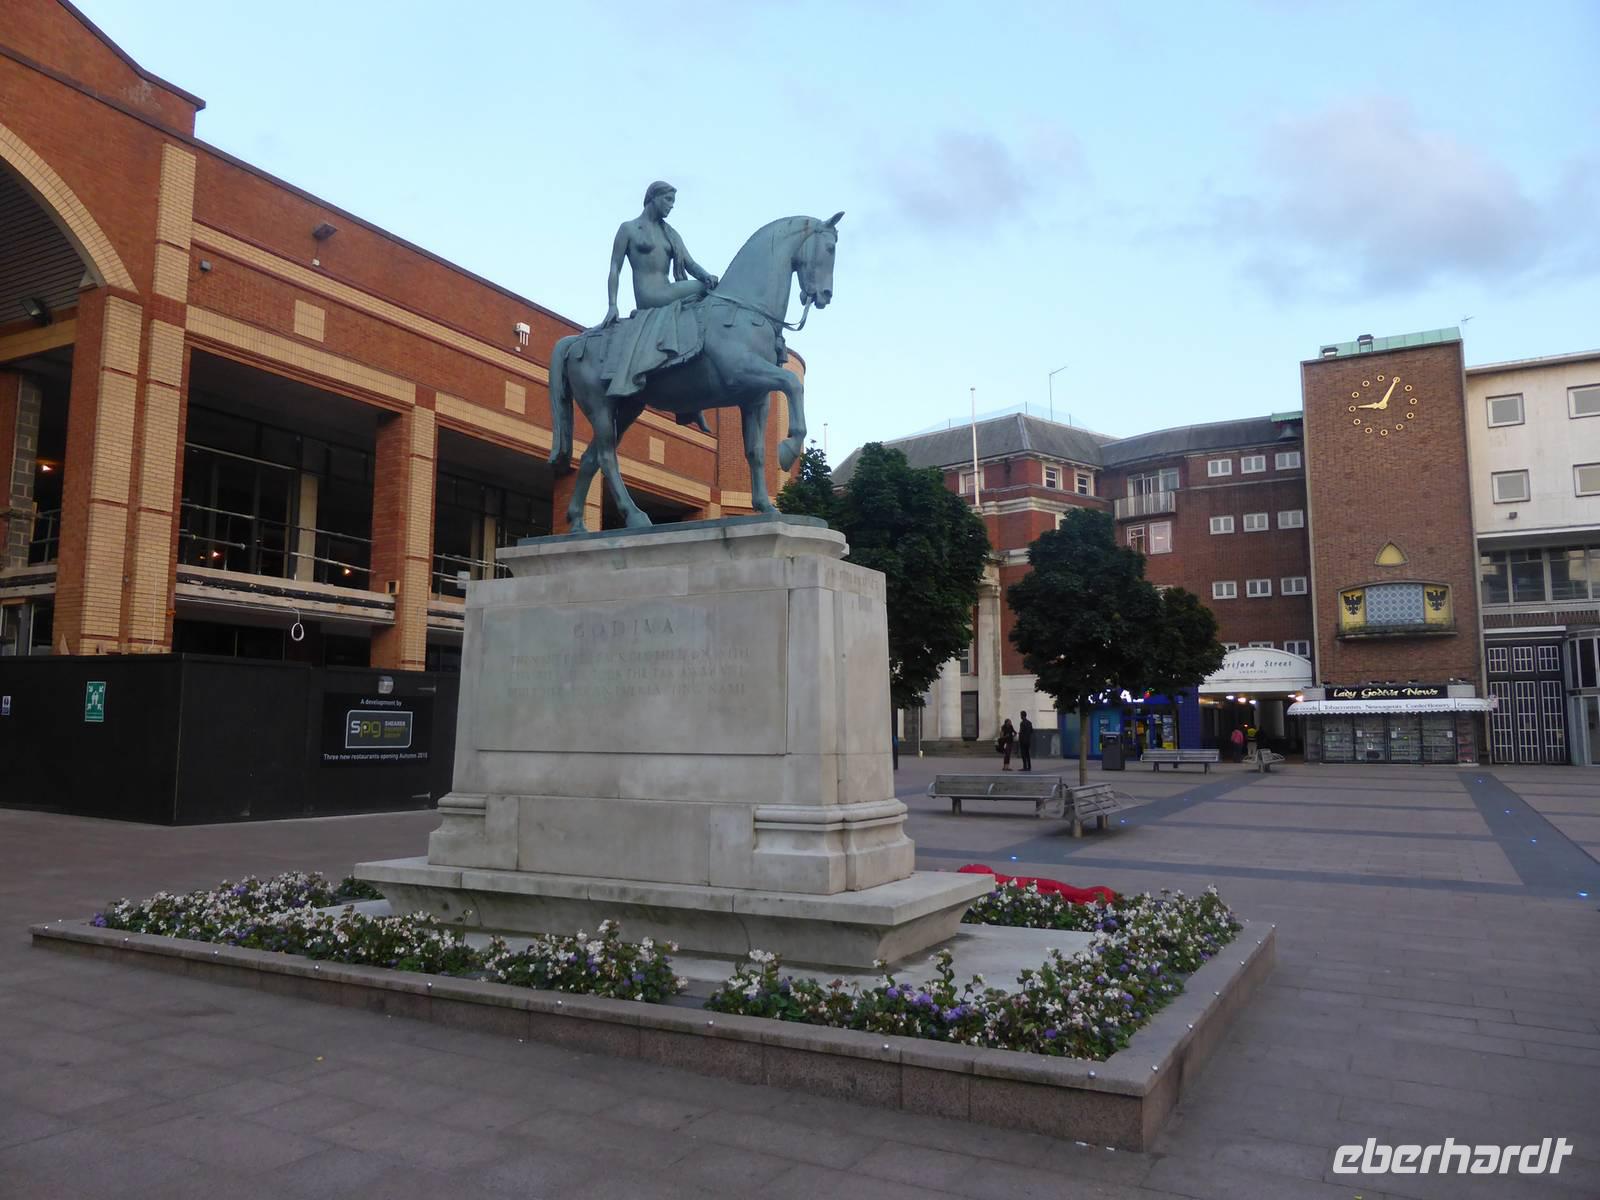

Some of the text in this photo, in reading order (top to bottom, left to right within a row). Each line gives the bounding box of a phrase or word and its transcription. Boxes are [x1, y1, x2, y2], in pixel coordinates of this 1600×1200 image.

[573, 618, 675, 638] GODIVA
[1223, 660, 1292, 670] rtford Street
[1333, 687, 1439, 699] Lady Godiva News
[350, 720, 382, 738] spg
[380, 753, 398, 761] opening
